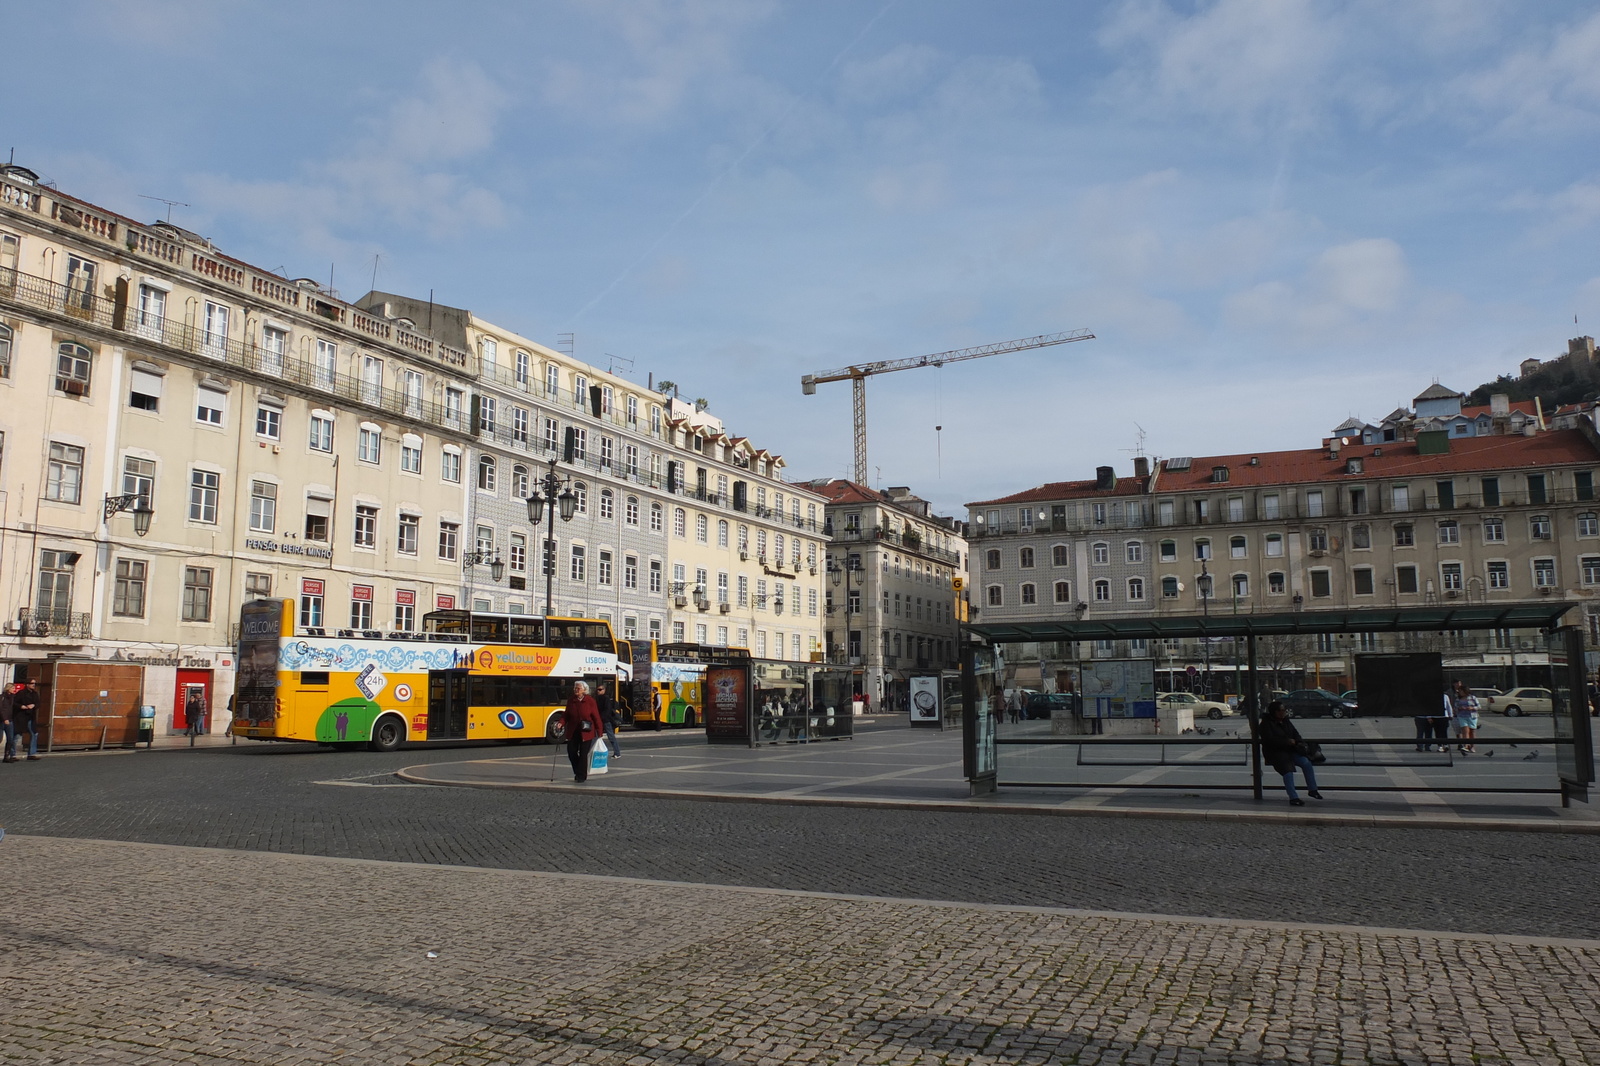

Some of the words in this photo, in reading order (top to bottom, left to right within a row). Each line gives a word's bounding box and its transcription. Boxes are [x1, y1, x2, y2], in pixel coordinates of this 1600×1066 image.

[246, 539, 278, 552] PENSÃO
[281, 543, 305, 556] BEIRA
[306, 547, 332, 559] MINHO
[953, 579, 961, 588] G
[243, 620, 279, 634] WELCOME
[127, 653, 183, 667] Santander
[184, 655, 211, 667] Totta
[536, 652, 553, 664] bus
[585, 656, 607, 664] LISBON
[367, 676, 384, 686] 24h
